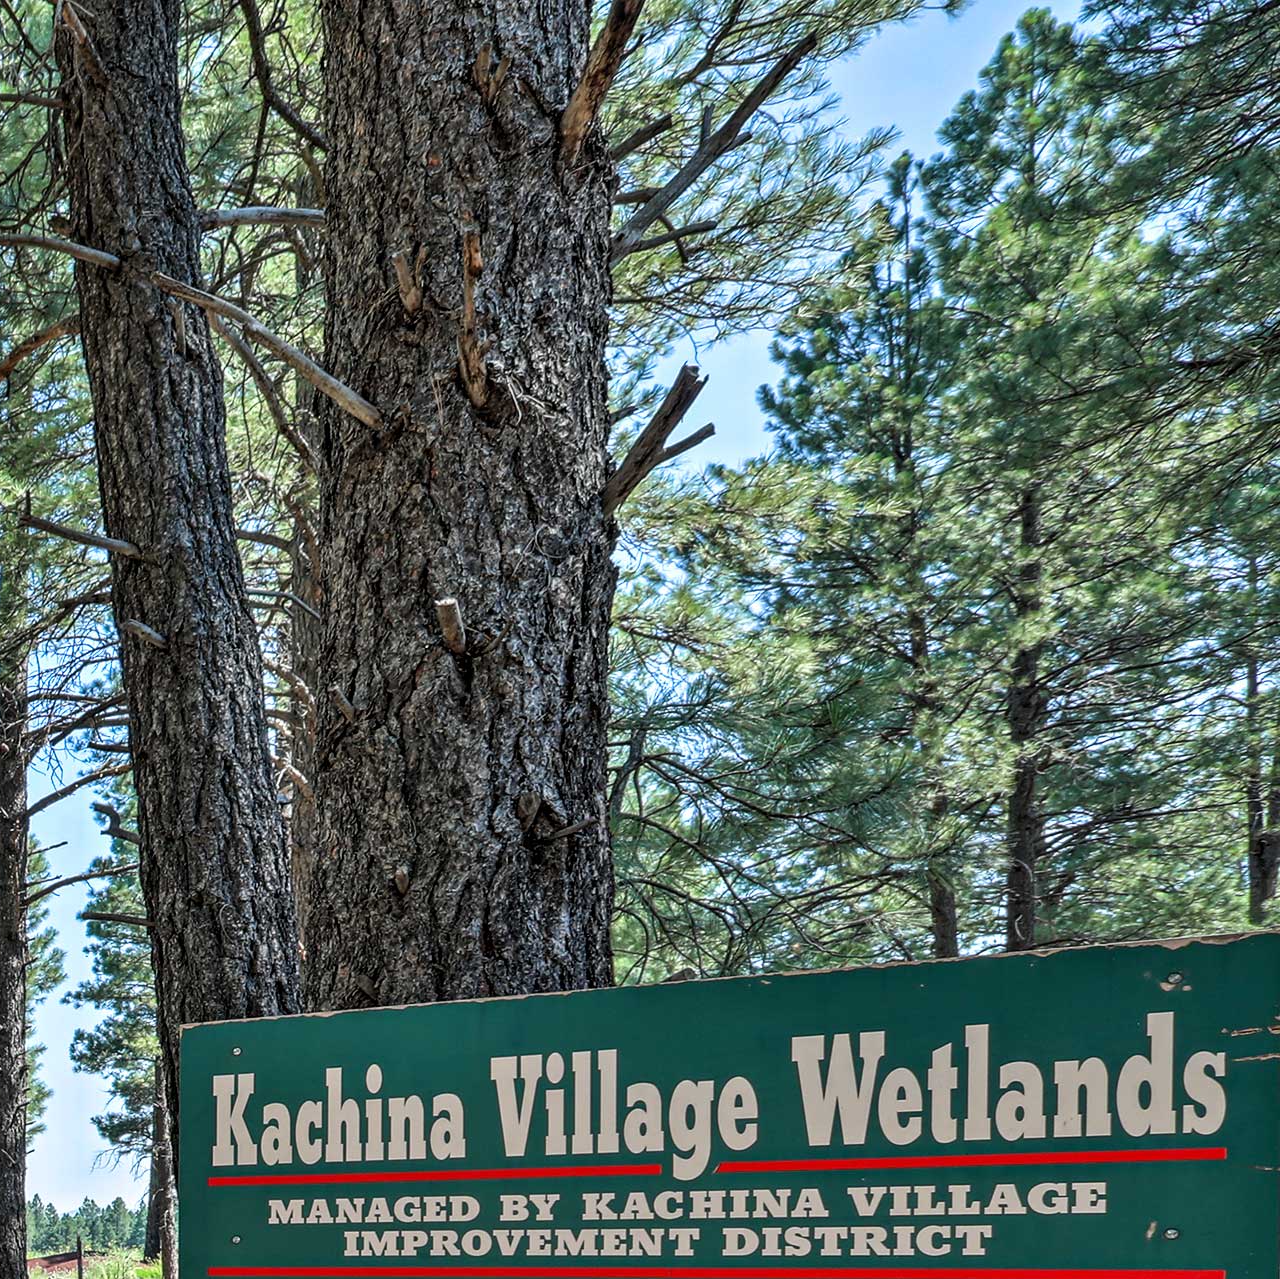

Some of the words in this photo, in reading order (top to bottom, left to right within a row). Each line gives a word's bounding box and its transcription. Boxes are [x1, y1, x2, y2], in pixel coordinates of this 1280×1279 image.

[212, 1063, 466, 1167] Kachina
[490, 1049, 759, 1181] Village
[791, 1011, 1227, 1147] Wetlands
[268, 1194, 481, 1225] MANAGED
[499, 1193, 561, 1222] BY
[582, 1188, 830, 1221] KACHINA
[847, 1181, 1107, 1217] VILLAGE
[343, 1227, 700, 1257] IMPROVEMENT
[722, 1224, 993, 1257] DISTRICT
